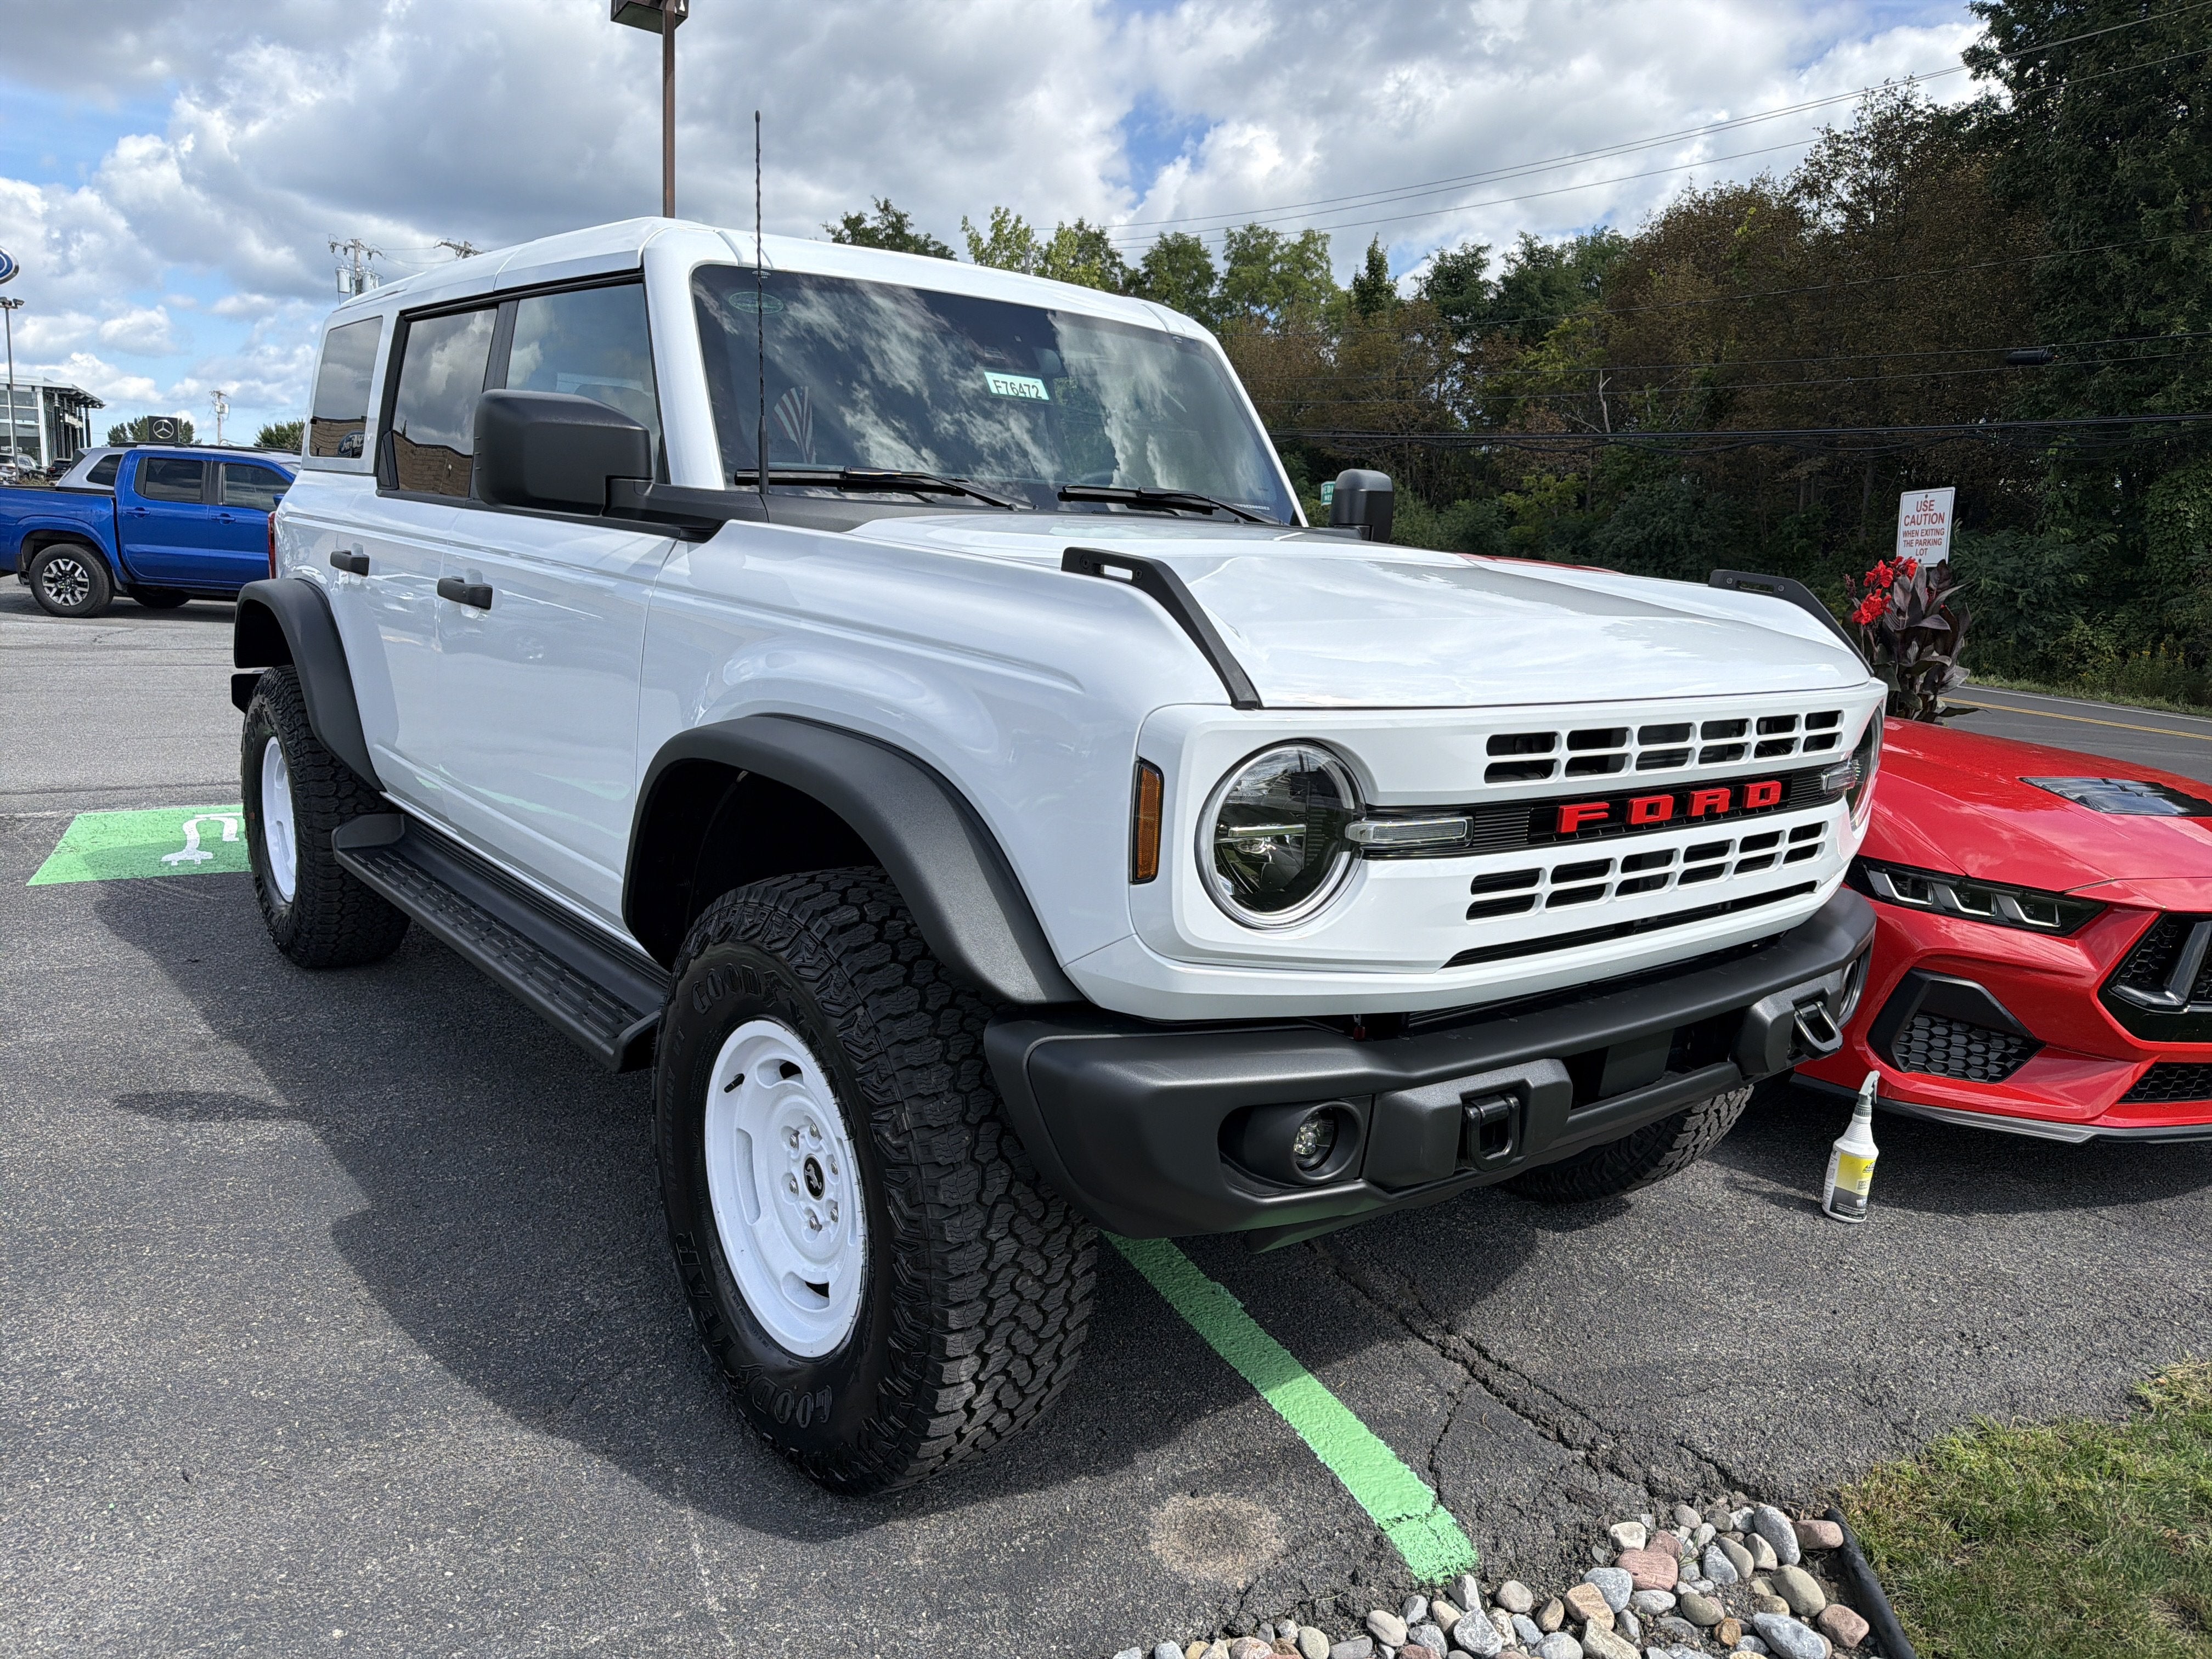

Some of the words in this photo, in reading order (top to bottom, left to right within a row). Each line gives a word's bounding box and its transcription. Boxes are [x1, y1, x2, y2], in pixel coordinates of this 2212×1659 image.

[992, 379, 1042, 399] F76472
[1916, 500, 1935, 512] USE
[1904, 513, 1945, 526] CAUTION
[1902, 529, 1919, 538] WHEN
[1920, 528, 1945, 537] EXITING
[1915, 538, 1942, 547] PARKING
[1558, 781, 1781, 833] FORD
